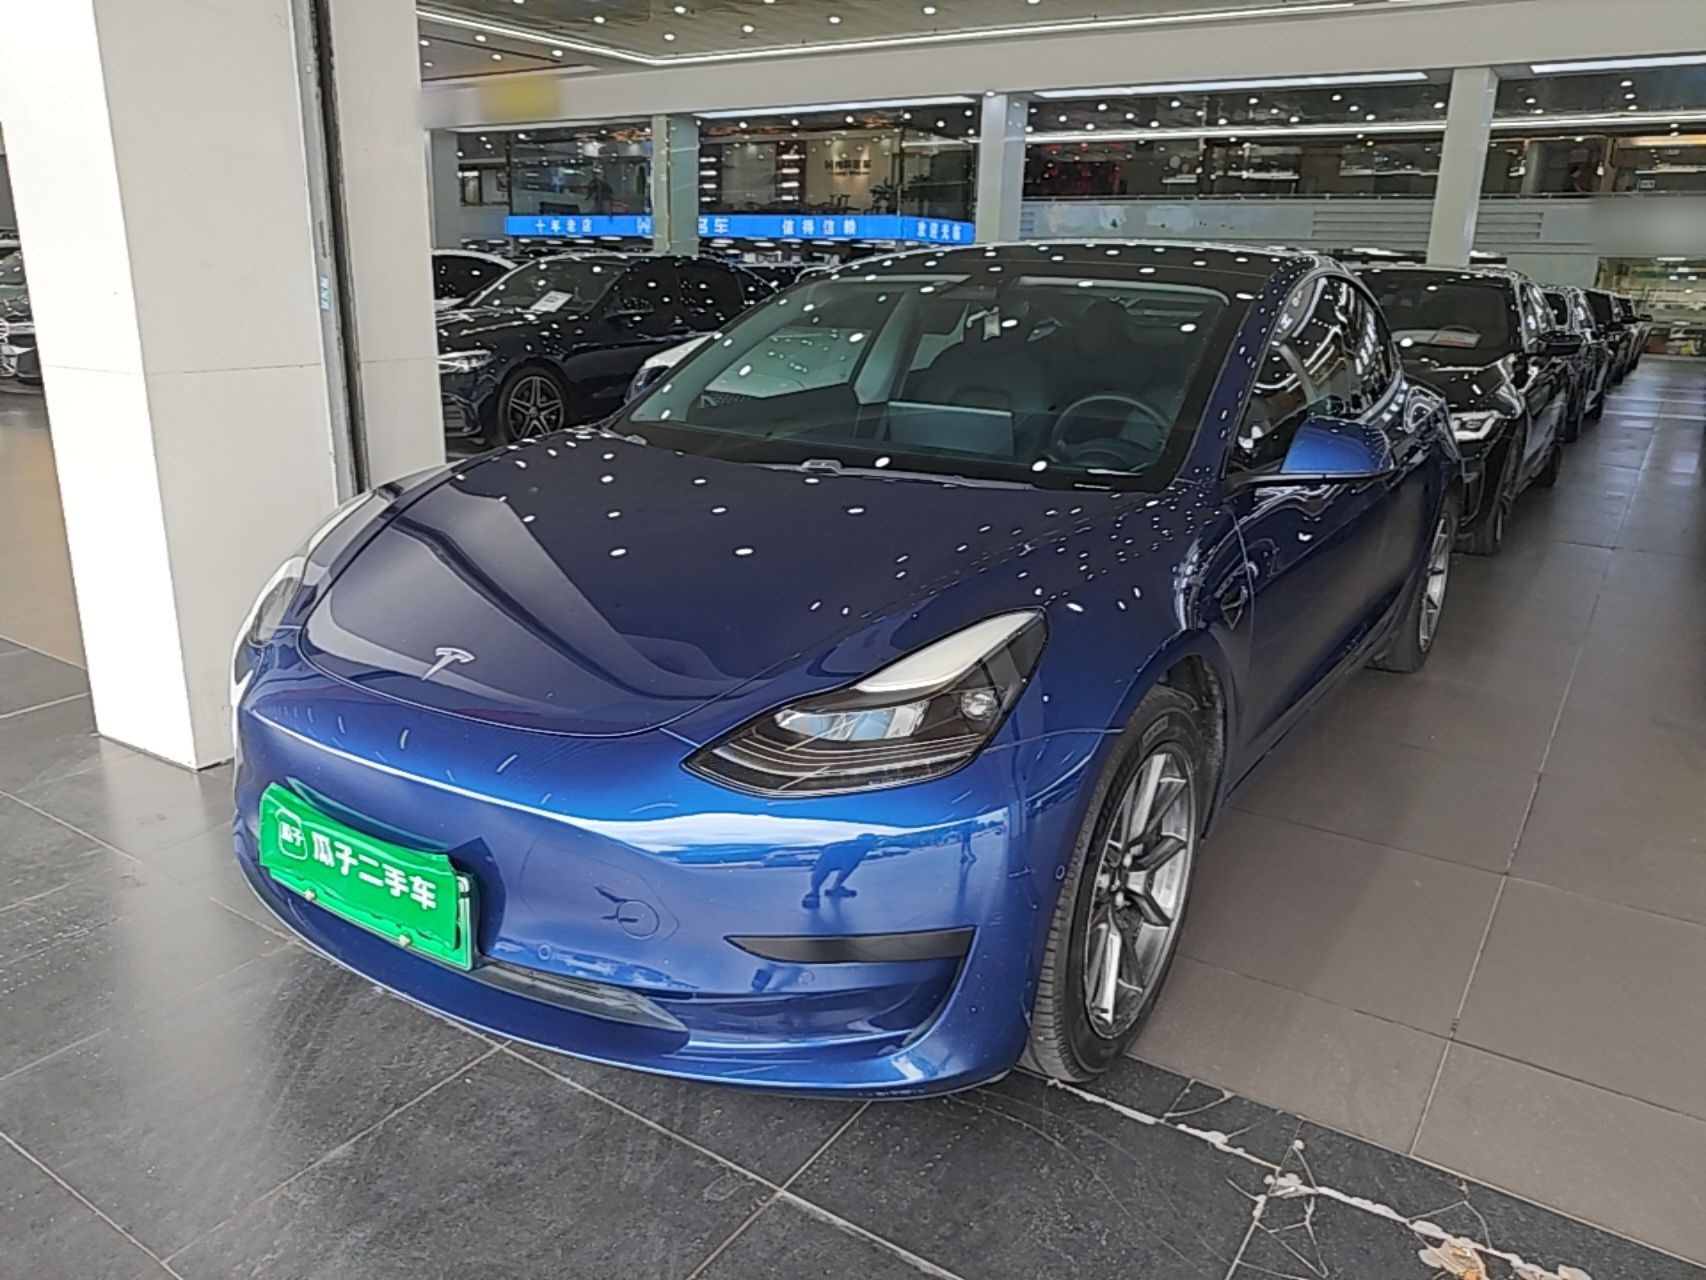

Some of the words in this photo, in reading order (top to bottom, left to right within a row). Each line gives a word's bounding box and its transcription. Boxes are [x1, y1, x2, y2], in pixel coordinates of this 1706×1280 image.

[311, 831, 437, 911] 瓜子二手车
